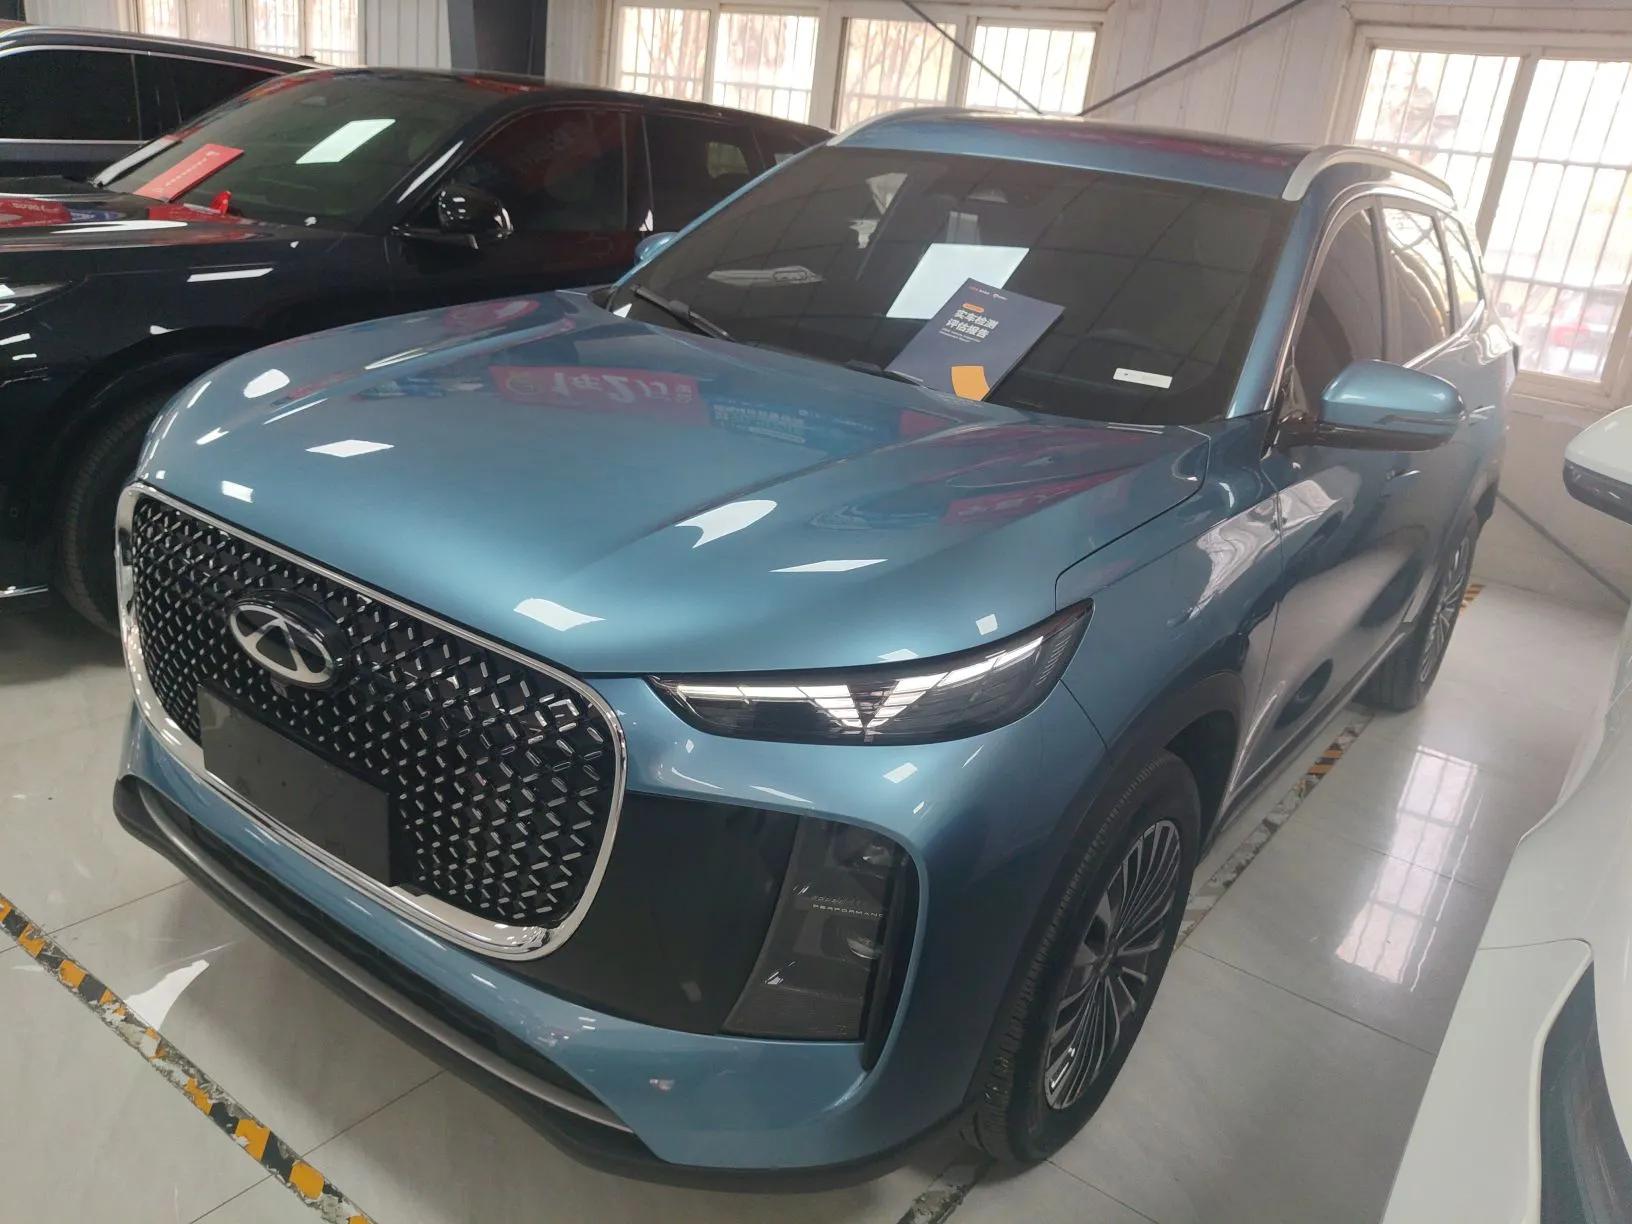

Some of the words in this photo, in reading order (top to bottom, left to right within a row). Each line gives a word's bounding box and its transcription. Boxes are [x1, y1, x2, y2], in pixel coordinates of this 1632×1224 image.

[945, 318, 990, 339] 评估报告
[954, 309, 999, 330] 实车检测
